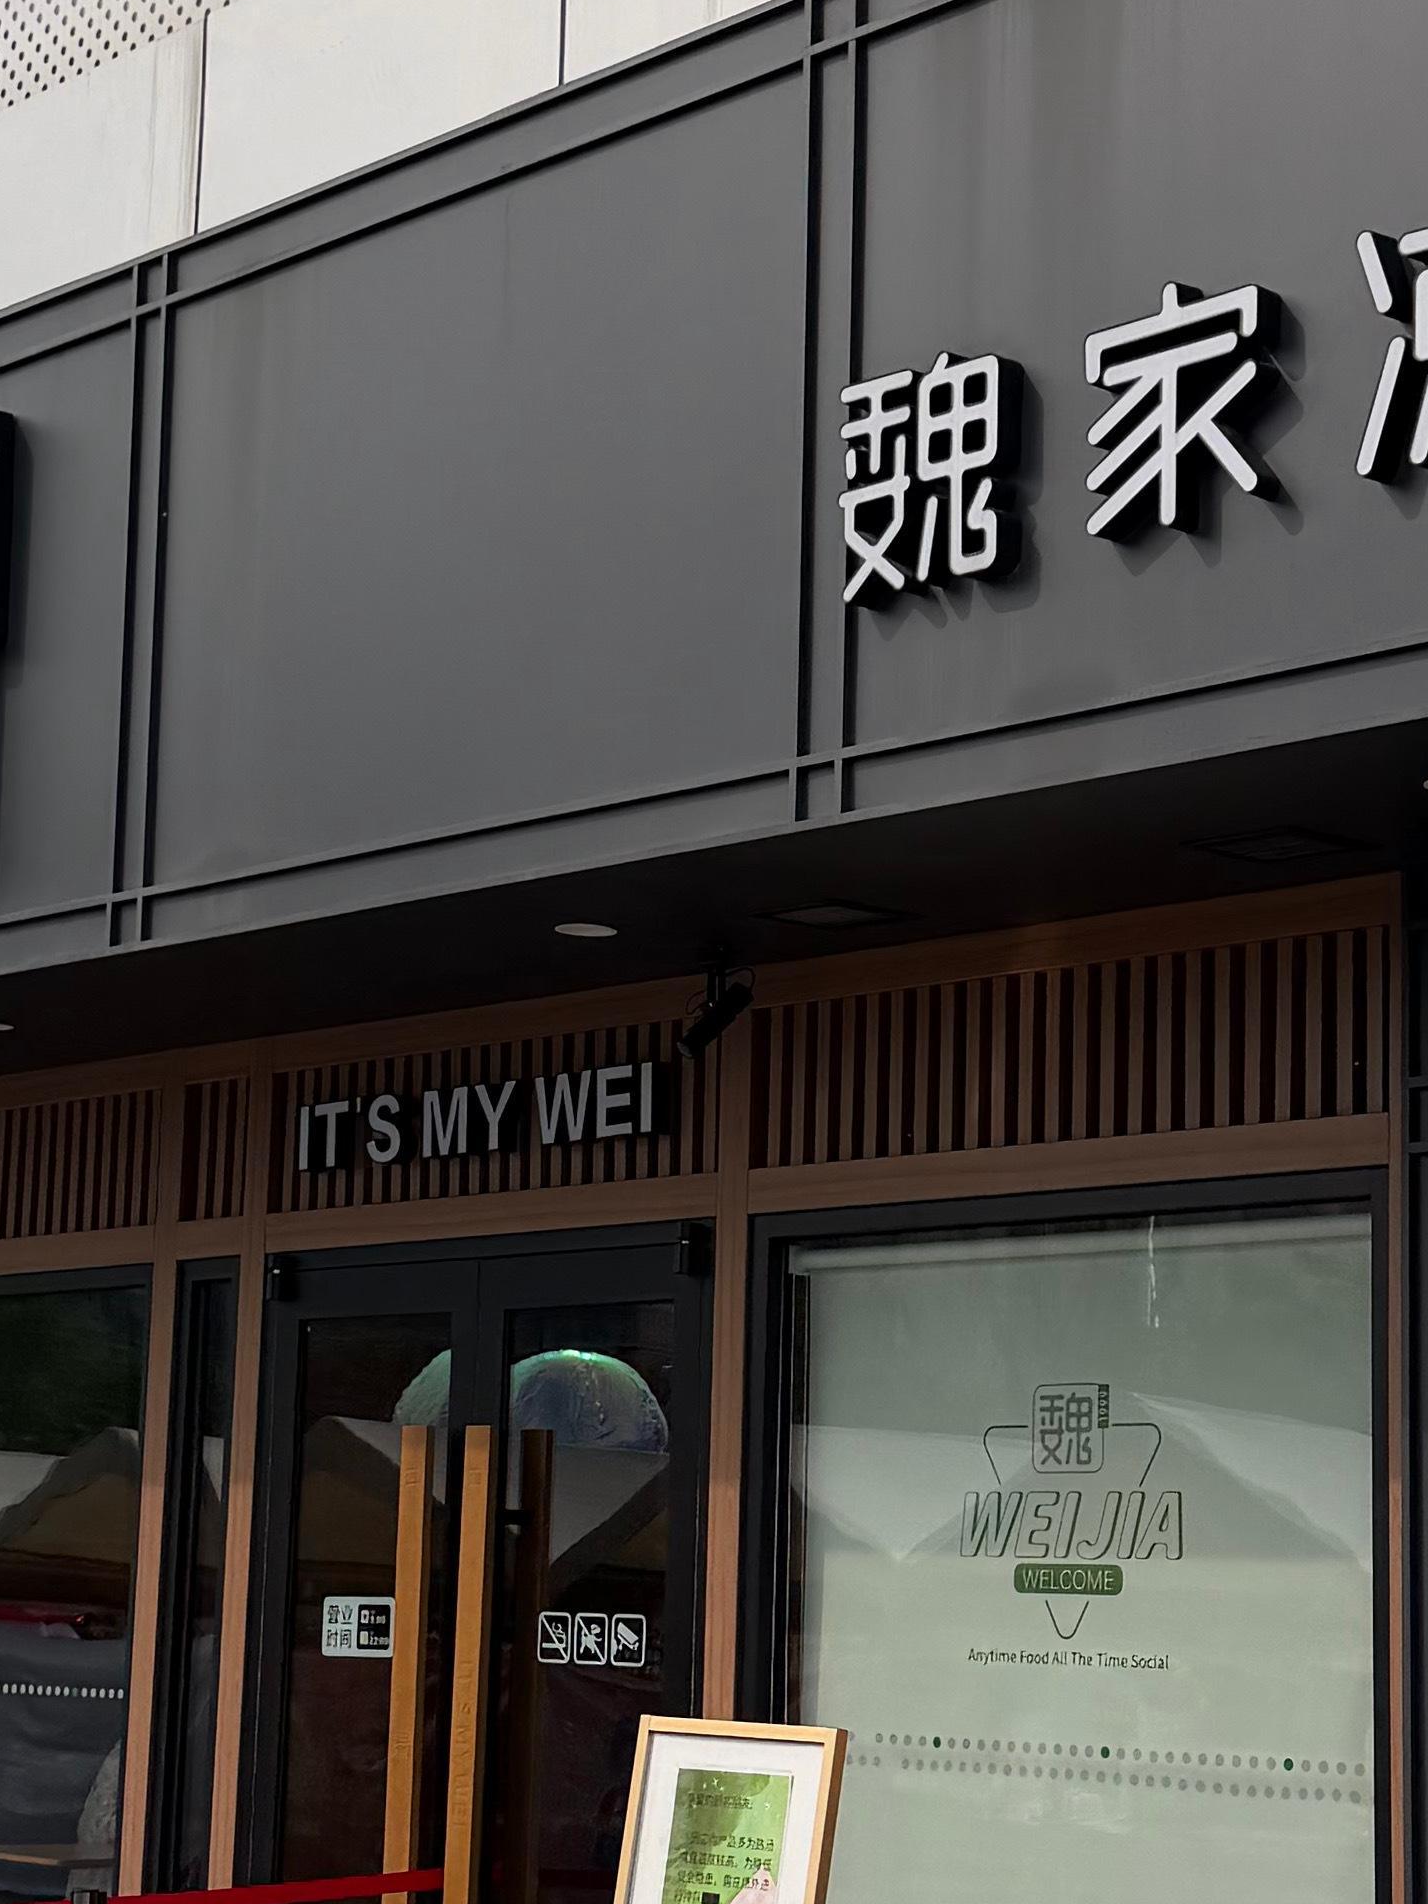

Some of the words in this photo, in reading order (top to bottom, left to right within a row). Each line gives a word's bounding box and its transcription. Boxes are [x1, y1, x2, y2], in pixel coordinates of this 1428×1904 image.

[298, 1094, 401, 1171] IT'S
[422, 1080, 517, 1159] MY
[535, 1062, 653, 1145] WEI
[1039, 1392, 1093, 1465] 魏
[960, 1490, 1183, 1561] WEIJIA
[1022, 1568, 1115, 1591] WELCOME
[968, 1648, 1017, 1666] Anytime
[1020, 1650, 1049, 1665] Food
[1052, 1651, 1067, 1666] All
[1071, 1651, 1093, 1667] The
[1097, 1652, 1128, 1668] Time
[1130, 1654, 1169, 1670] Social
